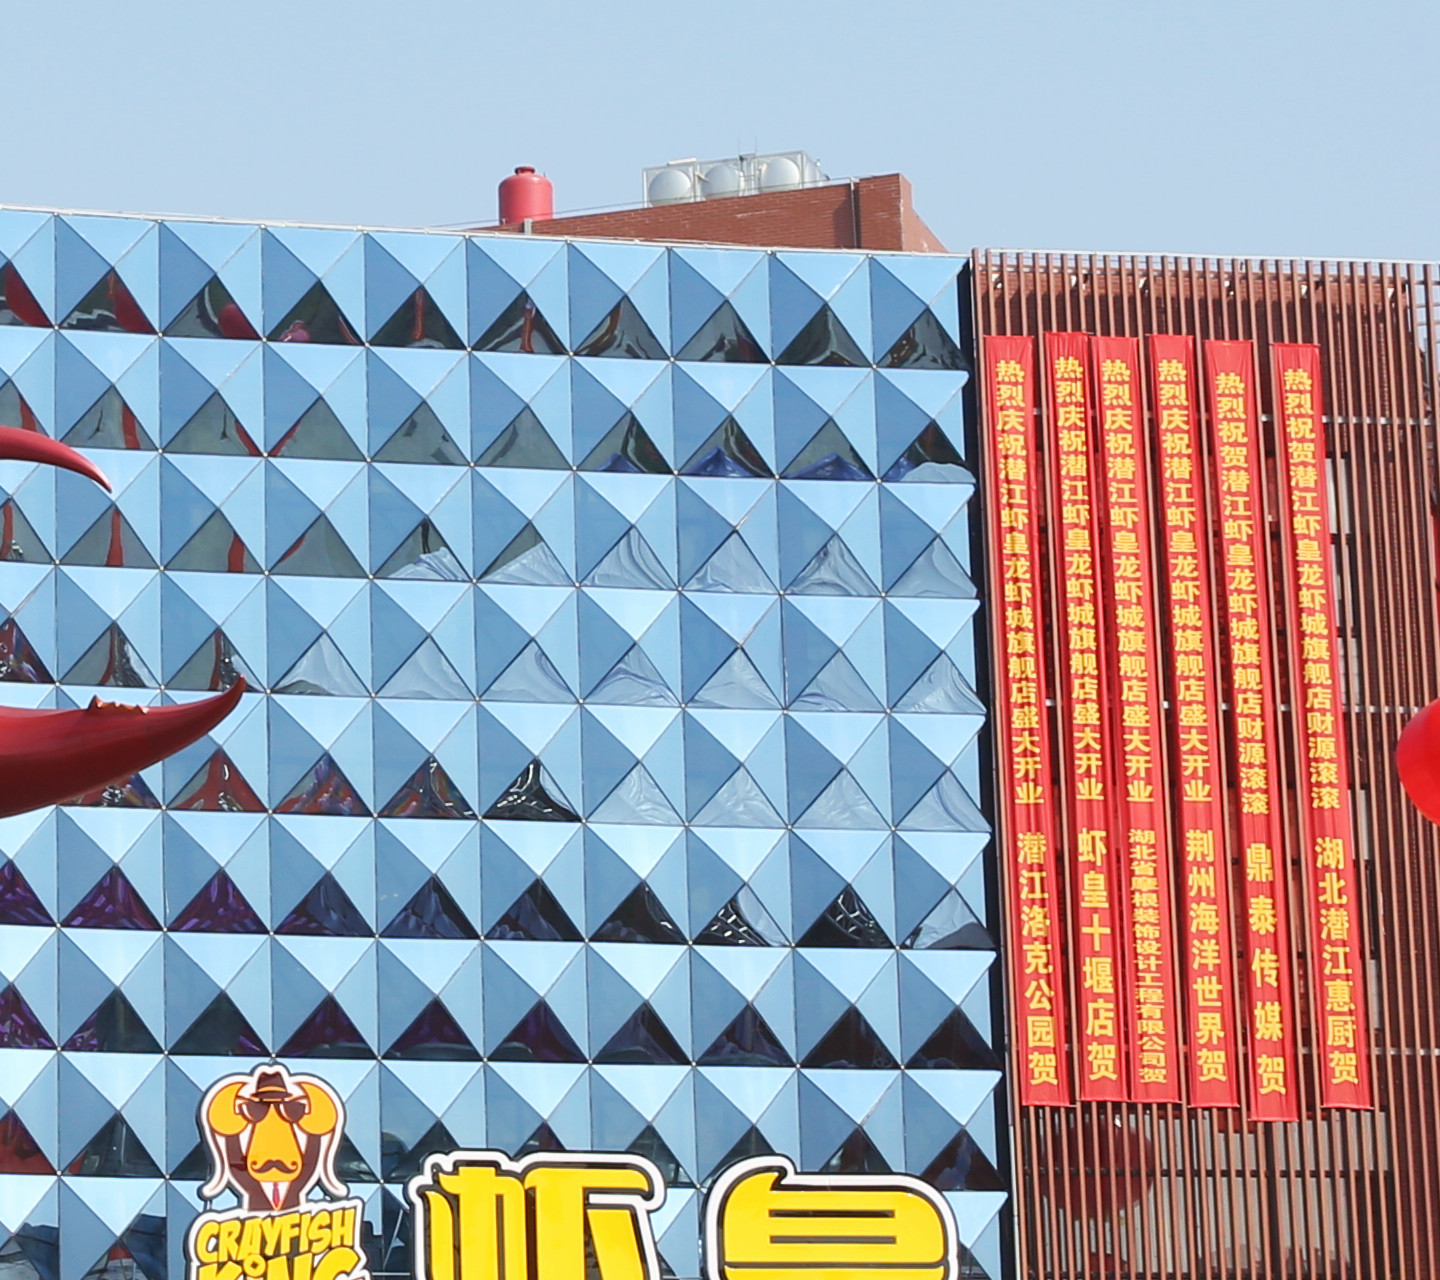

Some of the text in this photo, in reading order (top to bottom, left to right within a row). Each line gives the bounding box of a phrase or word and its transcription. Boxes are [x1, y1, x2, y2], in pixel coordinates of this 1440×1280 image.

[995, 359, 1059, 1086] 热烈庆祝潜江虾皇龙虾城旗舰店盛大开业 潜江洛克公园贺
[1055, 356, 1118, 1081] 热烈庆祝潜江虾皇龙虾城旗舰店盛大开业 虾皇十堰店贺
[1101, 359, 1155, 803] 热烈庆祝潜江虾皇龙虾城旗舰店盛大开业
[1157, 359, 1227, 1083] 热烈庆祝潜江虾皇龙虾城旗舰店盛大开业 荆州海洋世界贺
[1215, 372, 1287, 1096] 热烈祝贺潜江虾皇龙虾城旗舰店财源滚滚 鼎泰传媒贺
[1283, 368, 1359, 1085] 热烈祝贺潜江虾皇龙虾城旗舰店财源滚滚 湖北潜江惠厨贺
[196, 1208, 356, 1264] CRAYFISH
